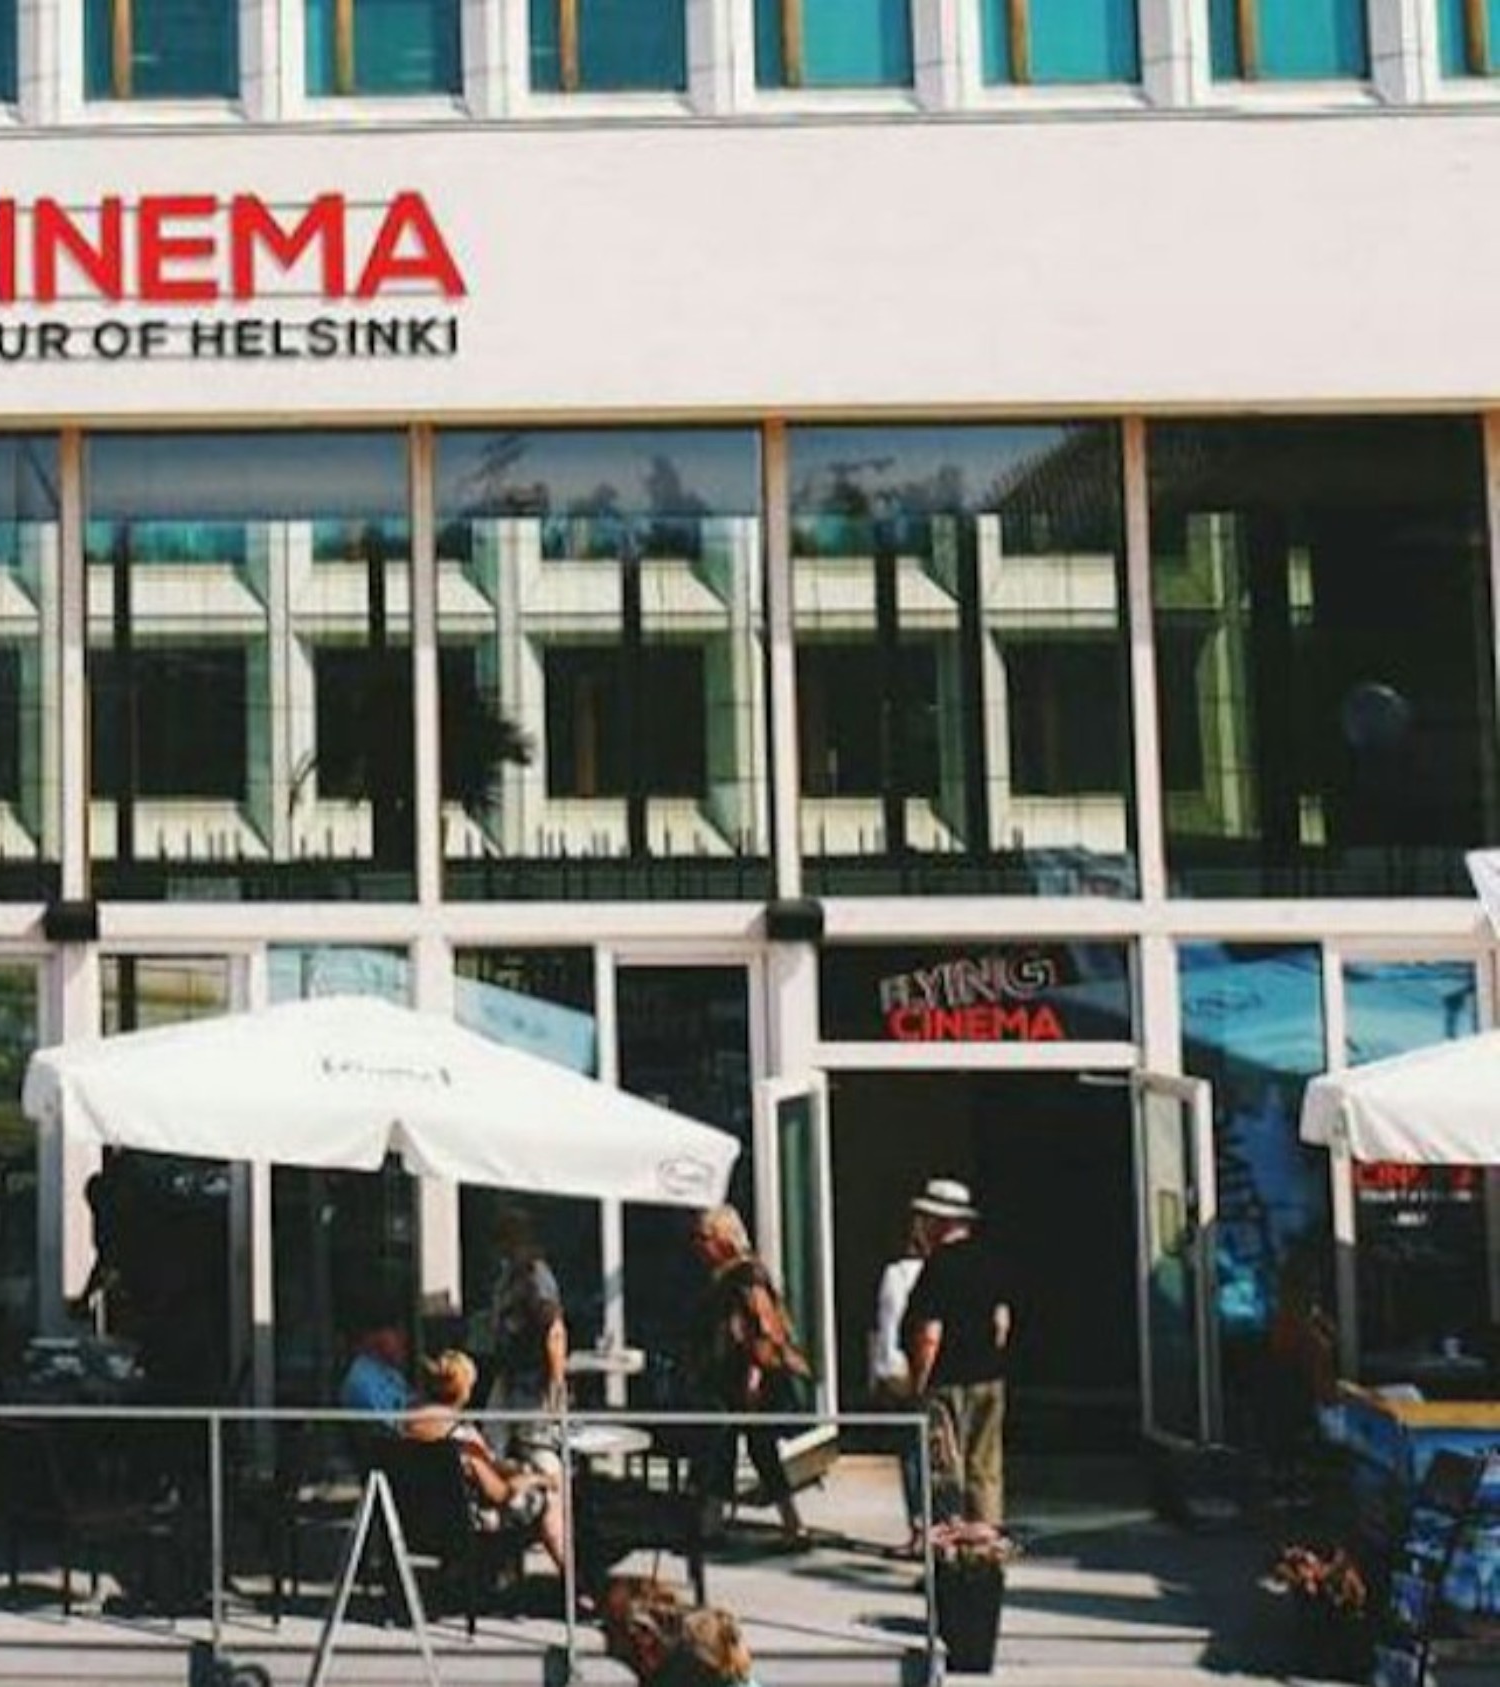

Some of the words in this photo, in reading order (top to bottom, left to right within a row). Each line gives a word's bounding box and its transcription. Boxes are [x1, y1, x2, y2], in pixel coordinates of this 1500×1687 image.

[92, 320, 170, 360] OF
[192, 315, 459, 359] HELSINKI
[888, 1004, 1065, 1042] CINEMA
